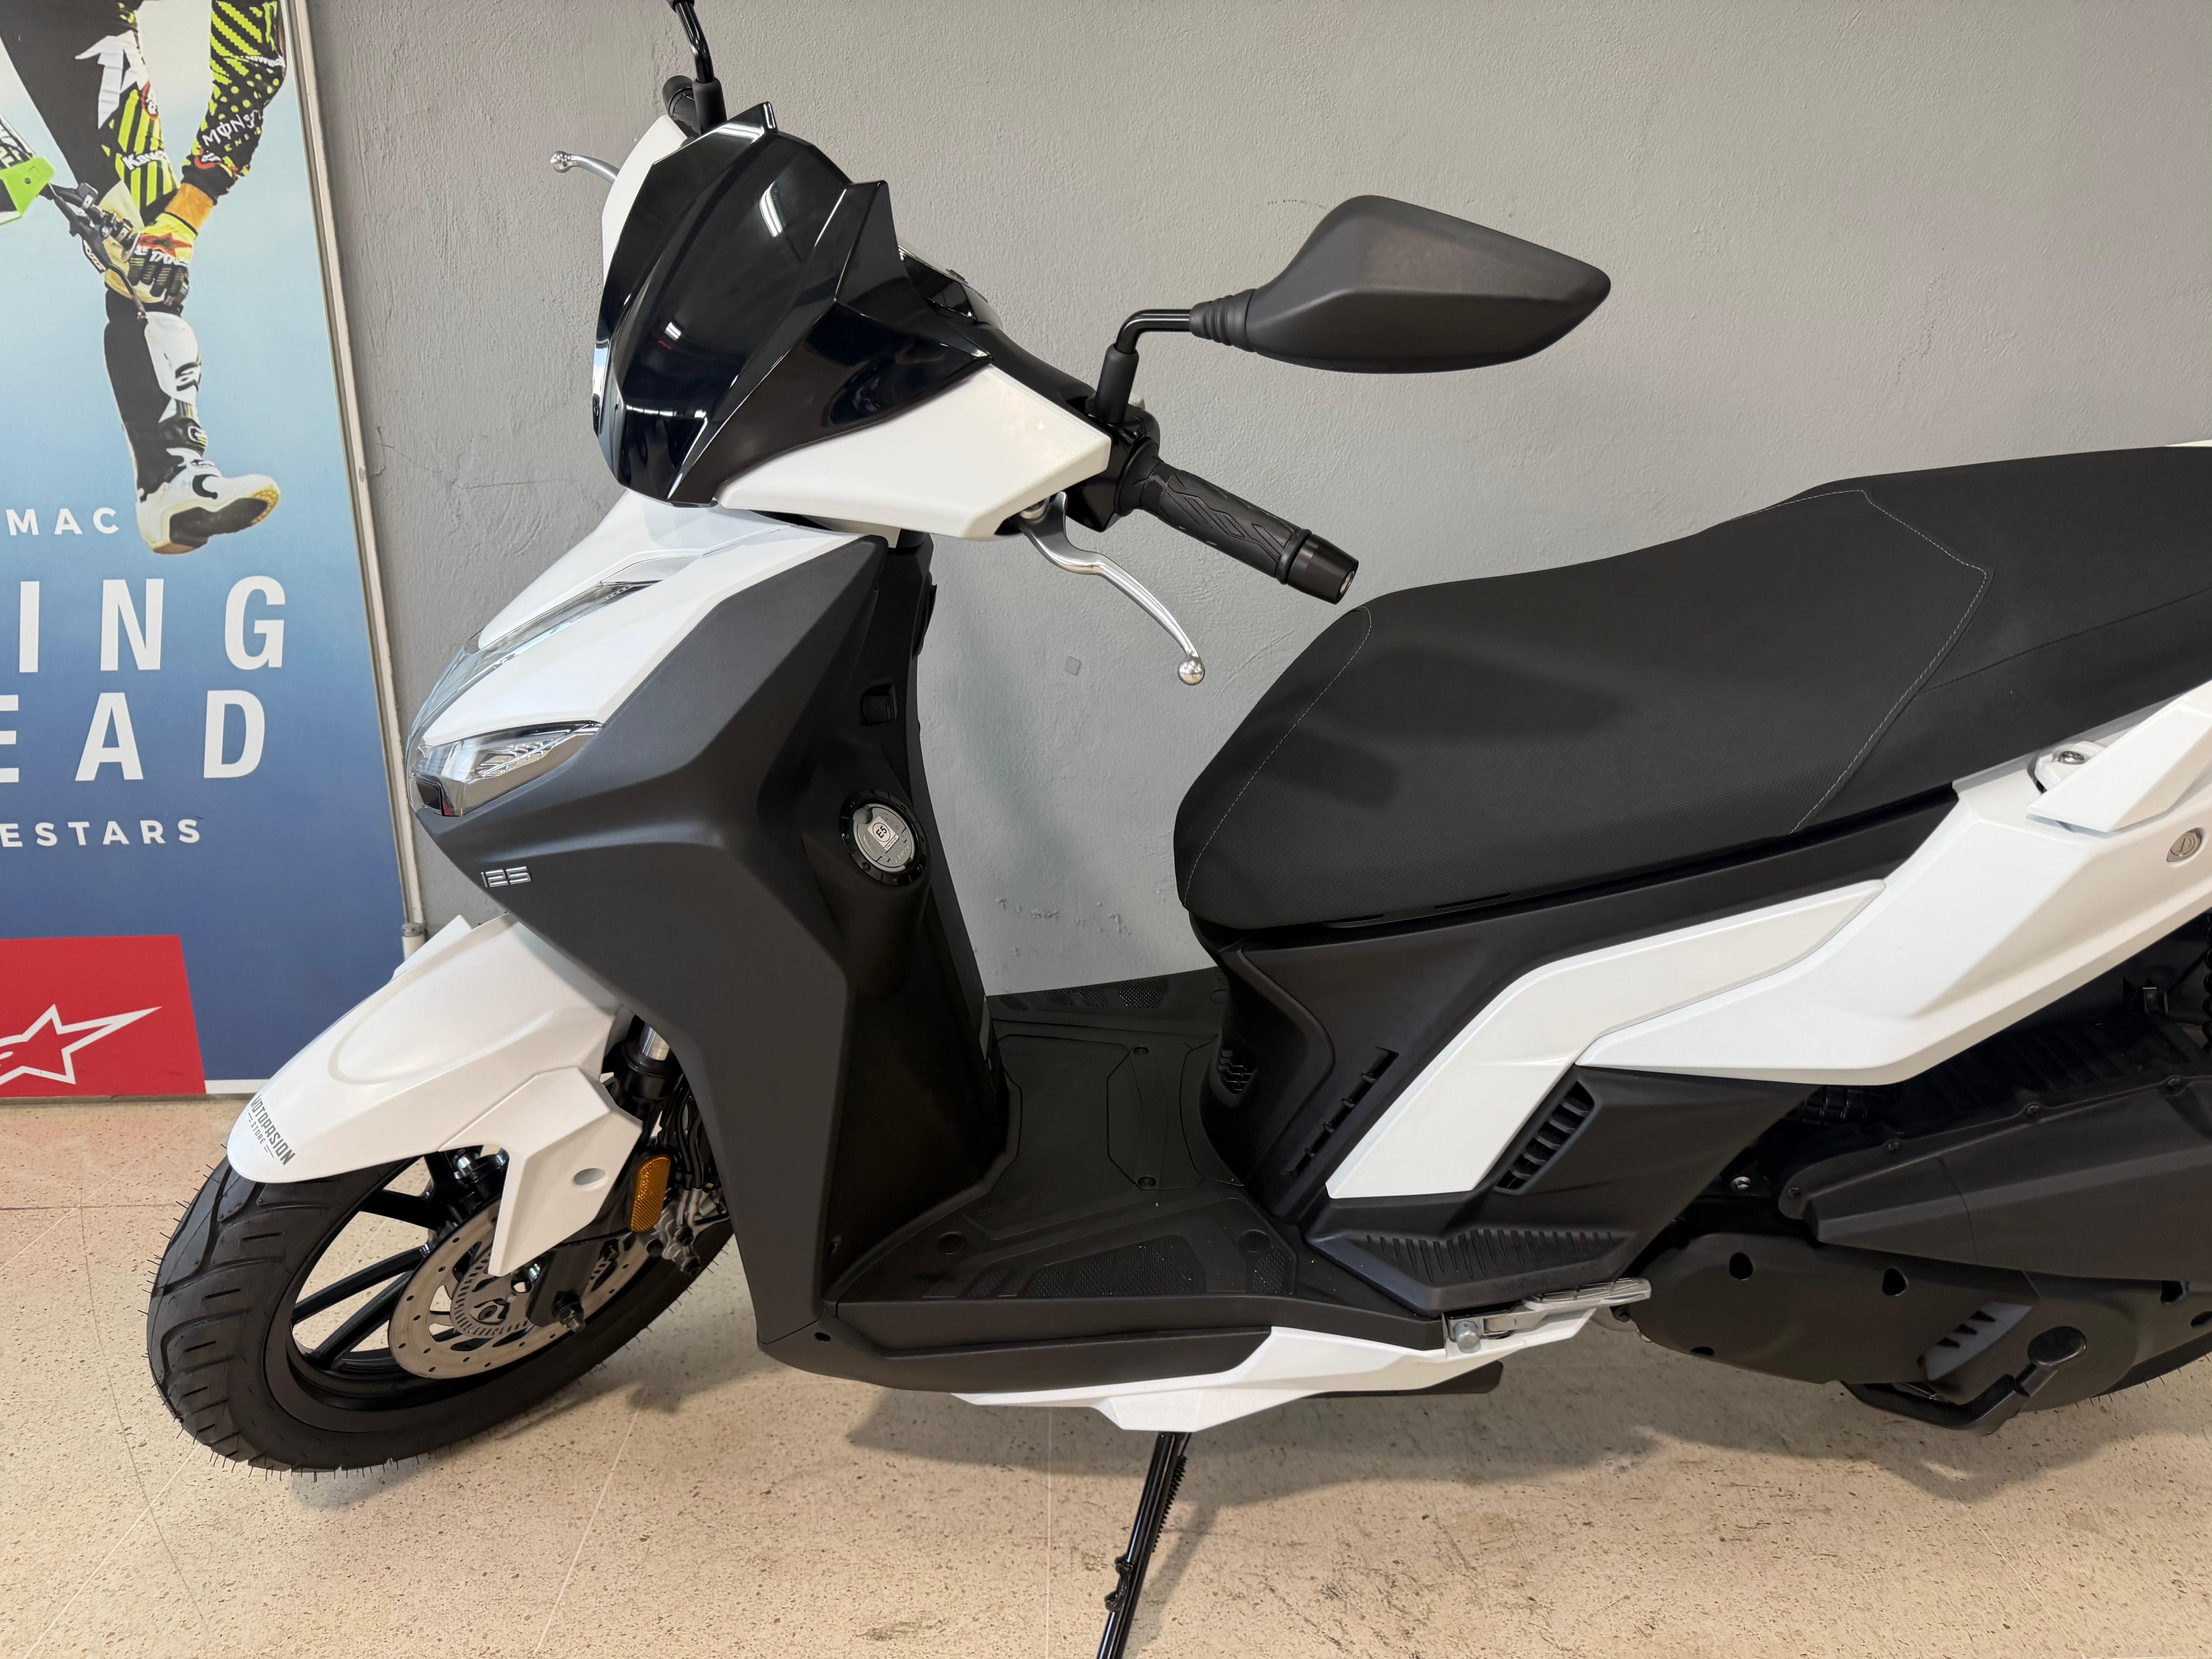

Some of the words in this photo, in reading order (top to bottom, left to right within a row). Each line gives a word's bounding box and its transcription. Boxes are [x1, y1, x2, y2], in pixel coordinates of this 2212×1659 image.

[6, 507, 119, 536] MAC
[19, 575, 286, 673] ING
[0, 819, 200, 847] ESTARS
[875, 826, 887, 839] E5
[480, 865, 532, 888] 125
[250, 1093, 296, 1166] MOTOPASION
[251, 1121, 266, 1145] STORE
